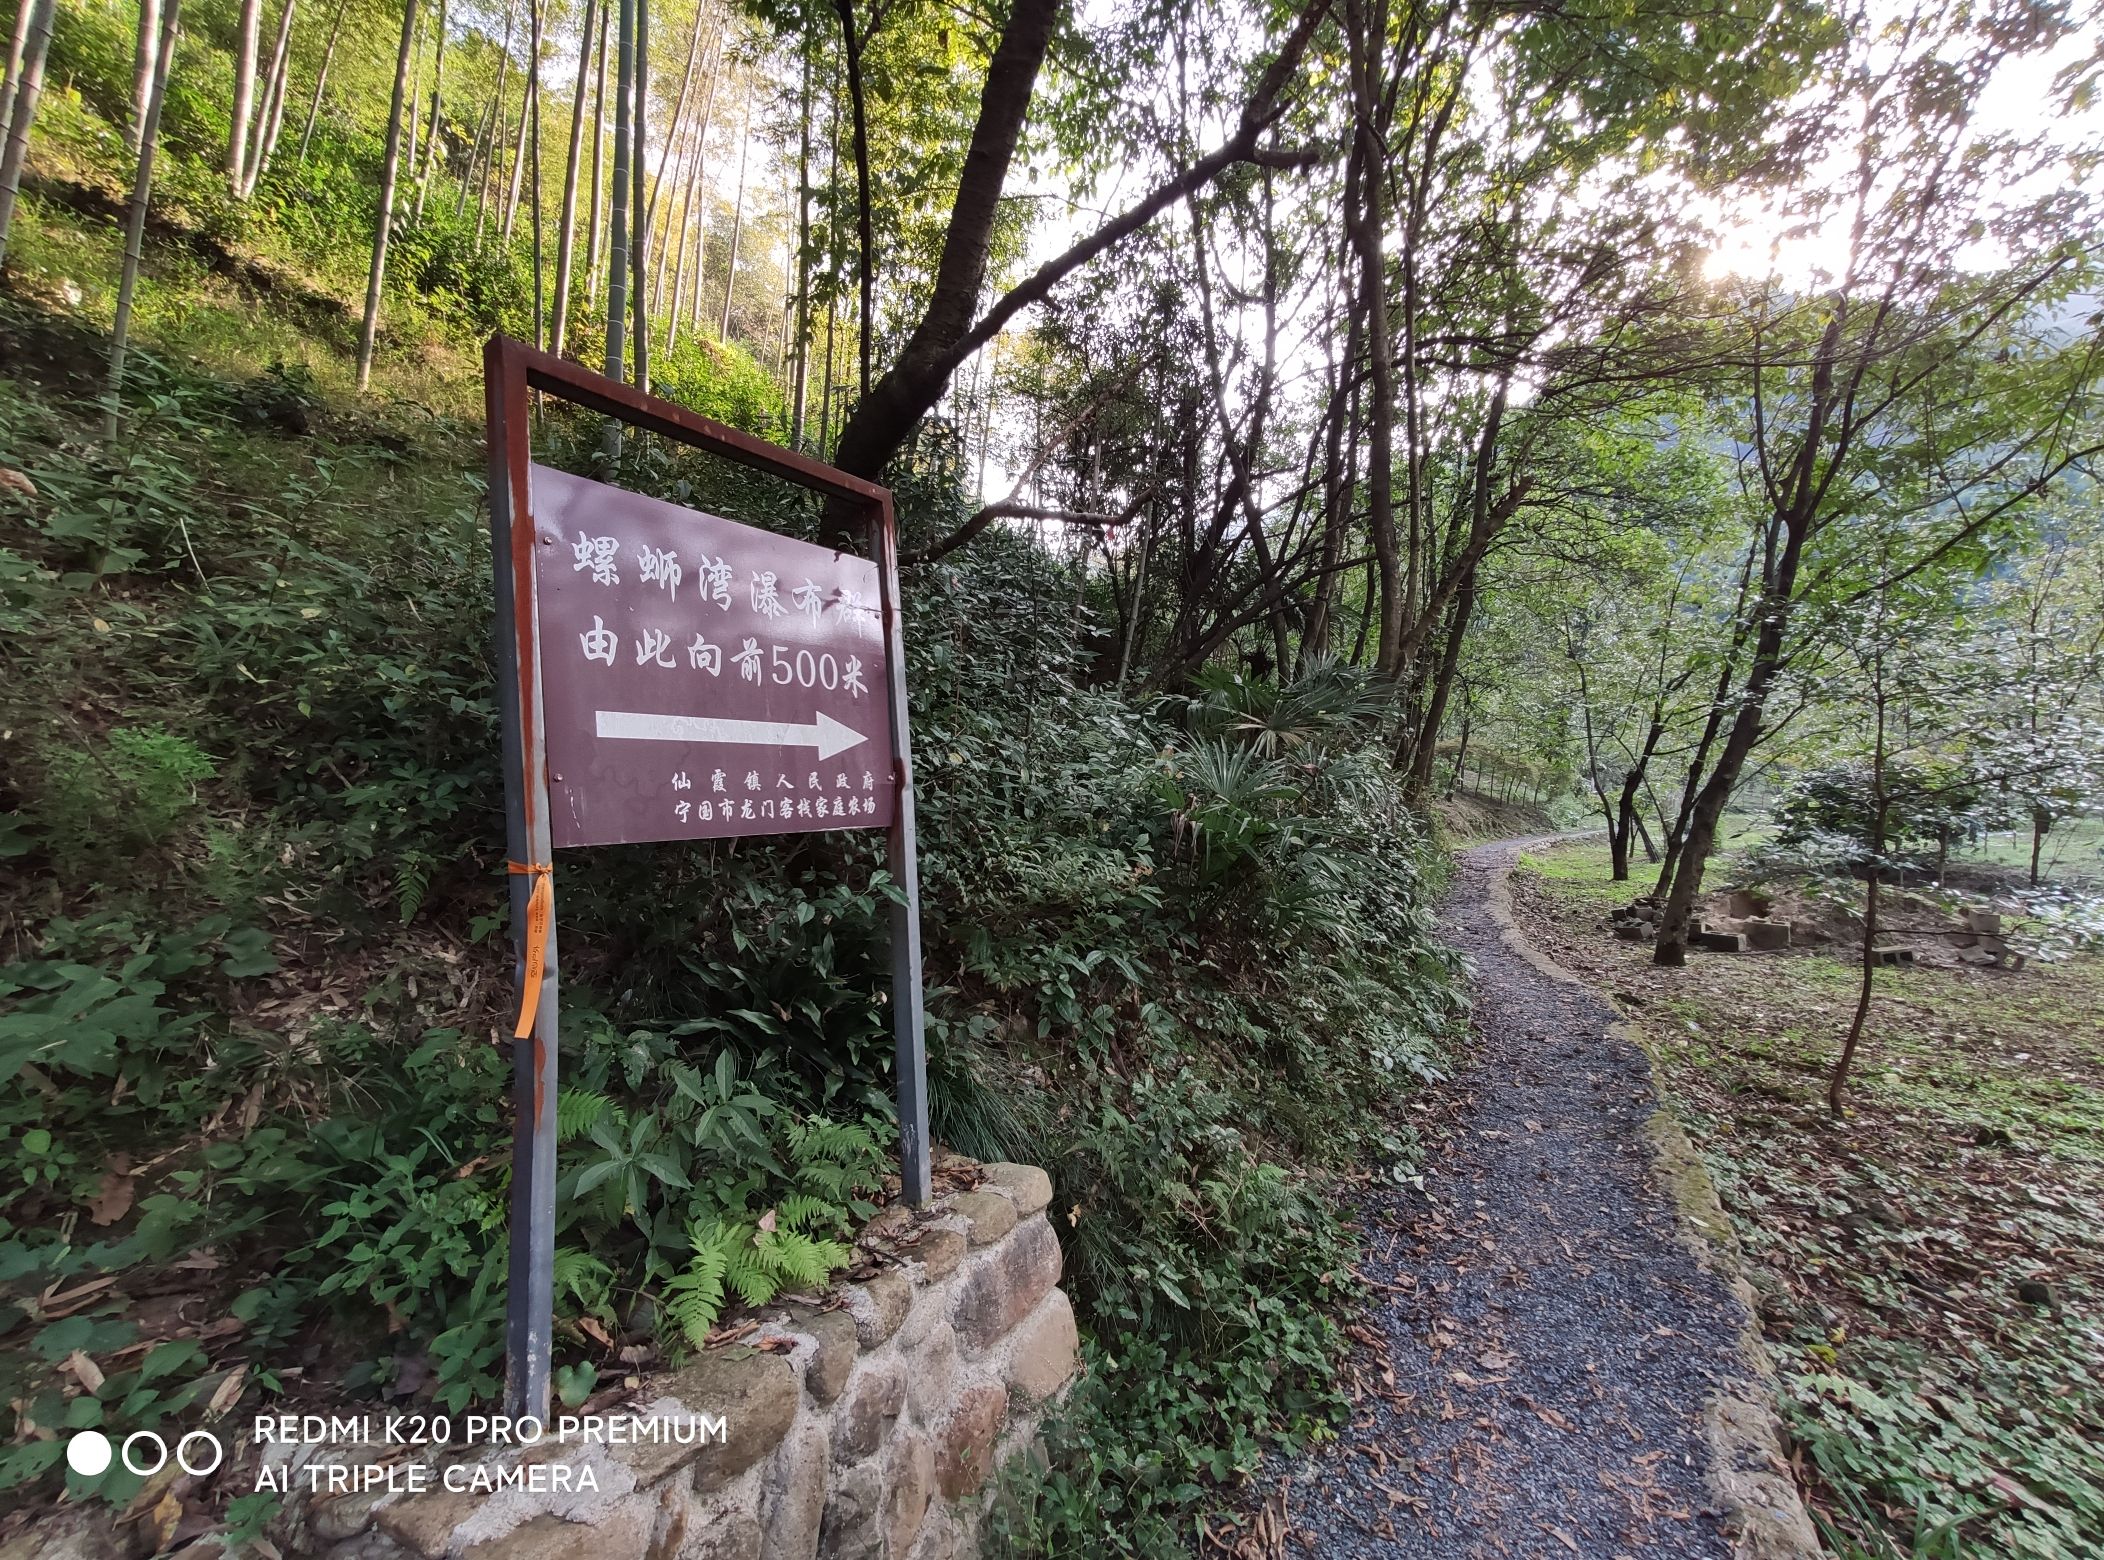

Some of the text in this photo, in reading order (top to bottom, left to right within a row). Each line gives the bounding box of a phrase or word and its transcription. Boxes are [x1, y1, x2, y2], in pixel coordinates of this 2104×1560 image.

[579, 615, 869, 699] 由此向前500米
[671, 768, 875, 793] 仙霞镇人民政府
[674, 795, 877, 823] 宁国市龙门客栈家庭农场
